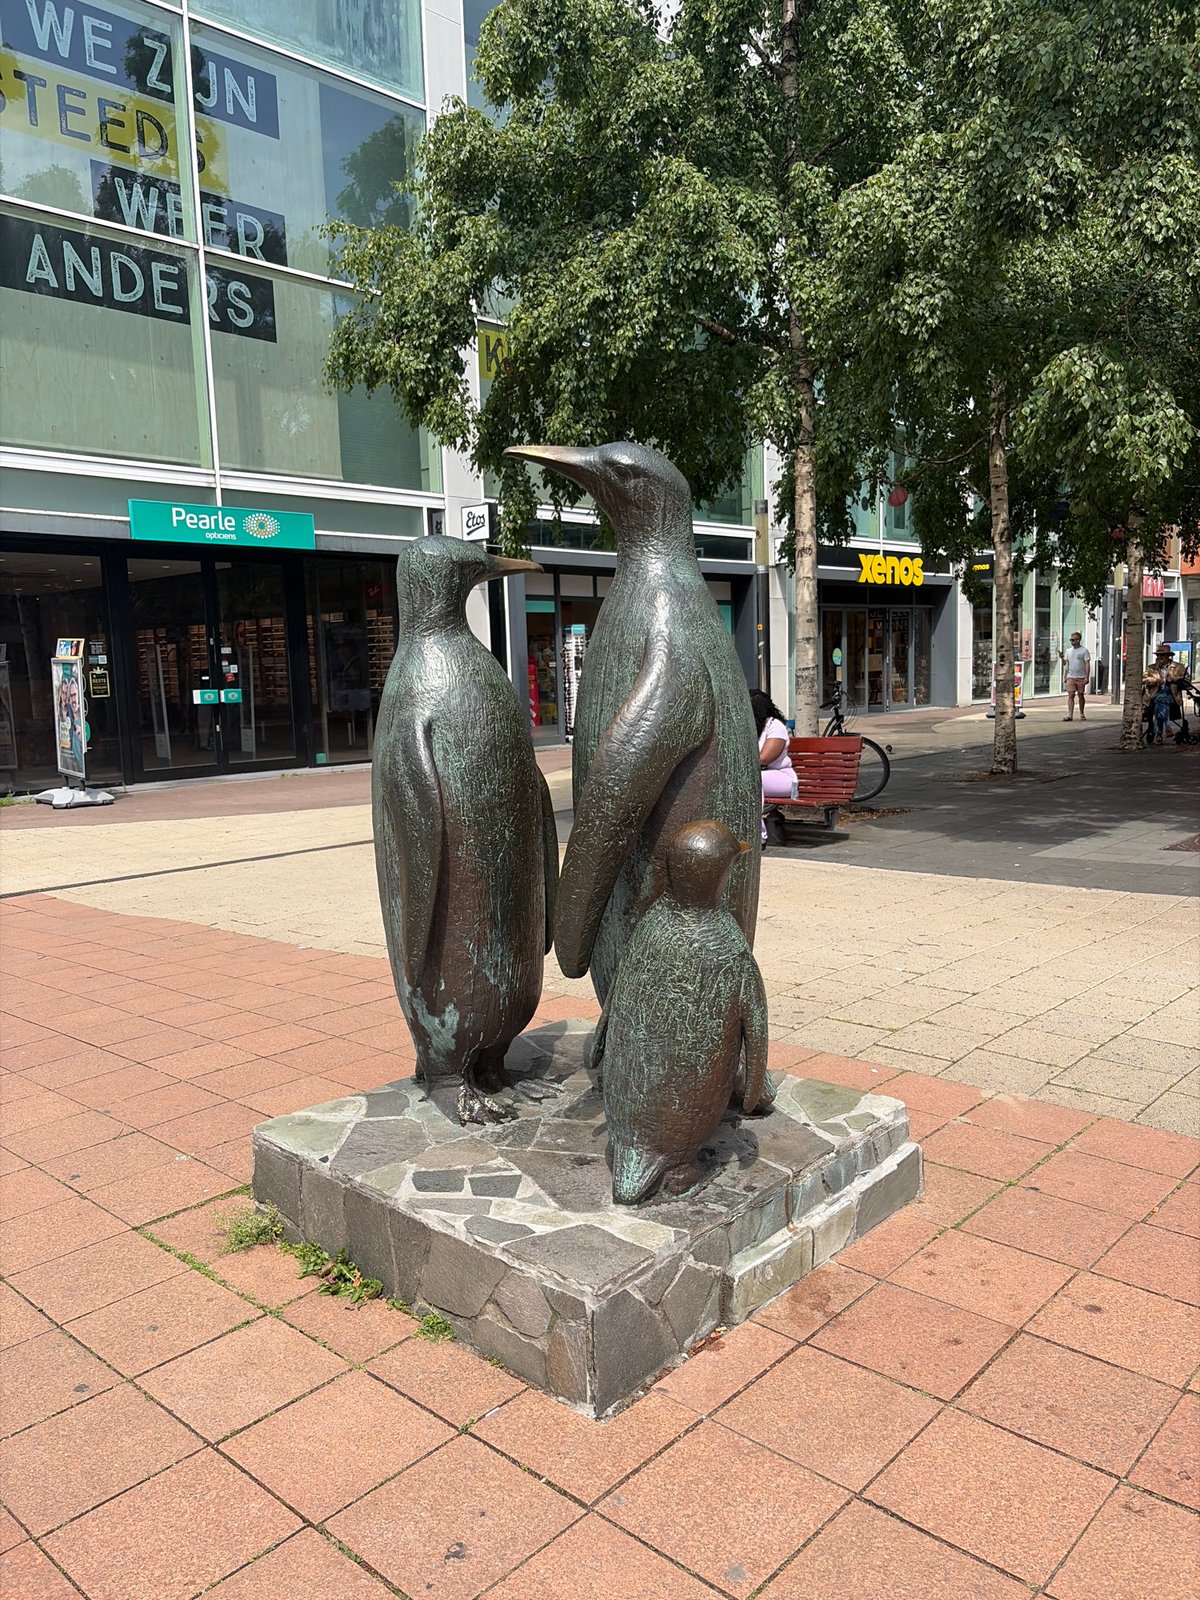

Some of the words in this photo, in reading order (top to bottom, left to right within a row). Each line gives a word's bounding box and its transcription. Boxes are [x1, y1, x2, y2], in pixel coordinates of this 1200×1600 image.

[25, 0, 117, 75] WE
[171, 507, 236, 531] Pearle
[466, 511, 486, 529] Etos
[205, 531, 237, 540] opticiens
[858, 553, 924, 586] xenos
